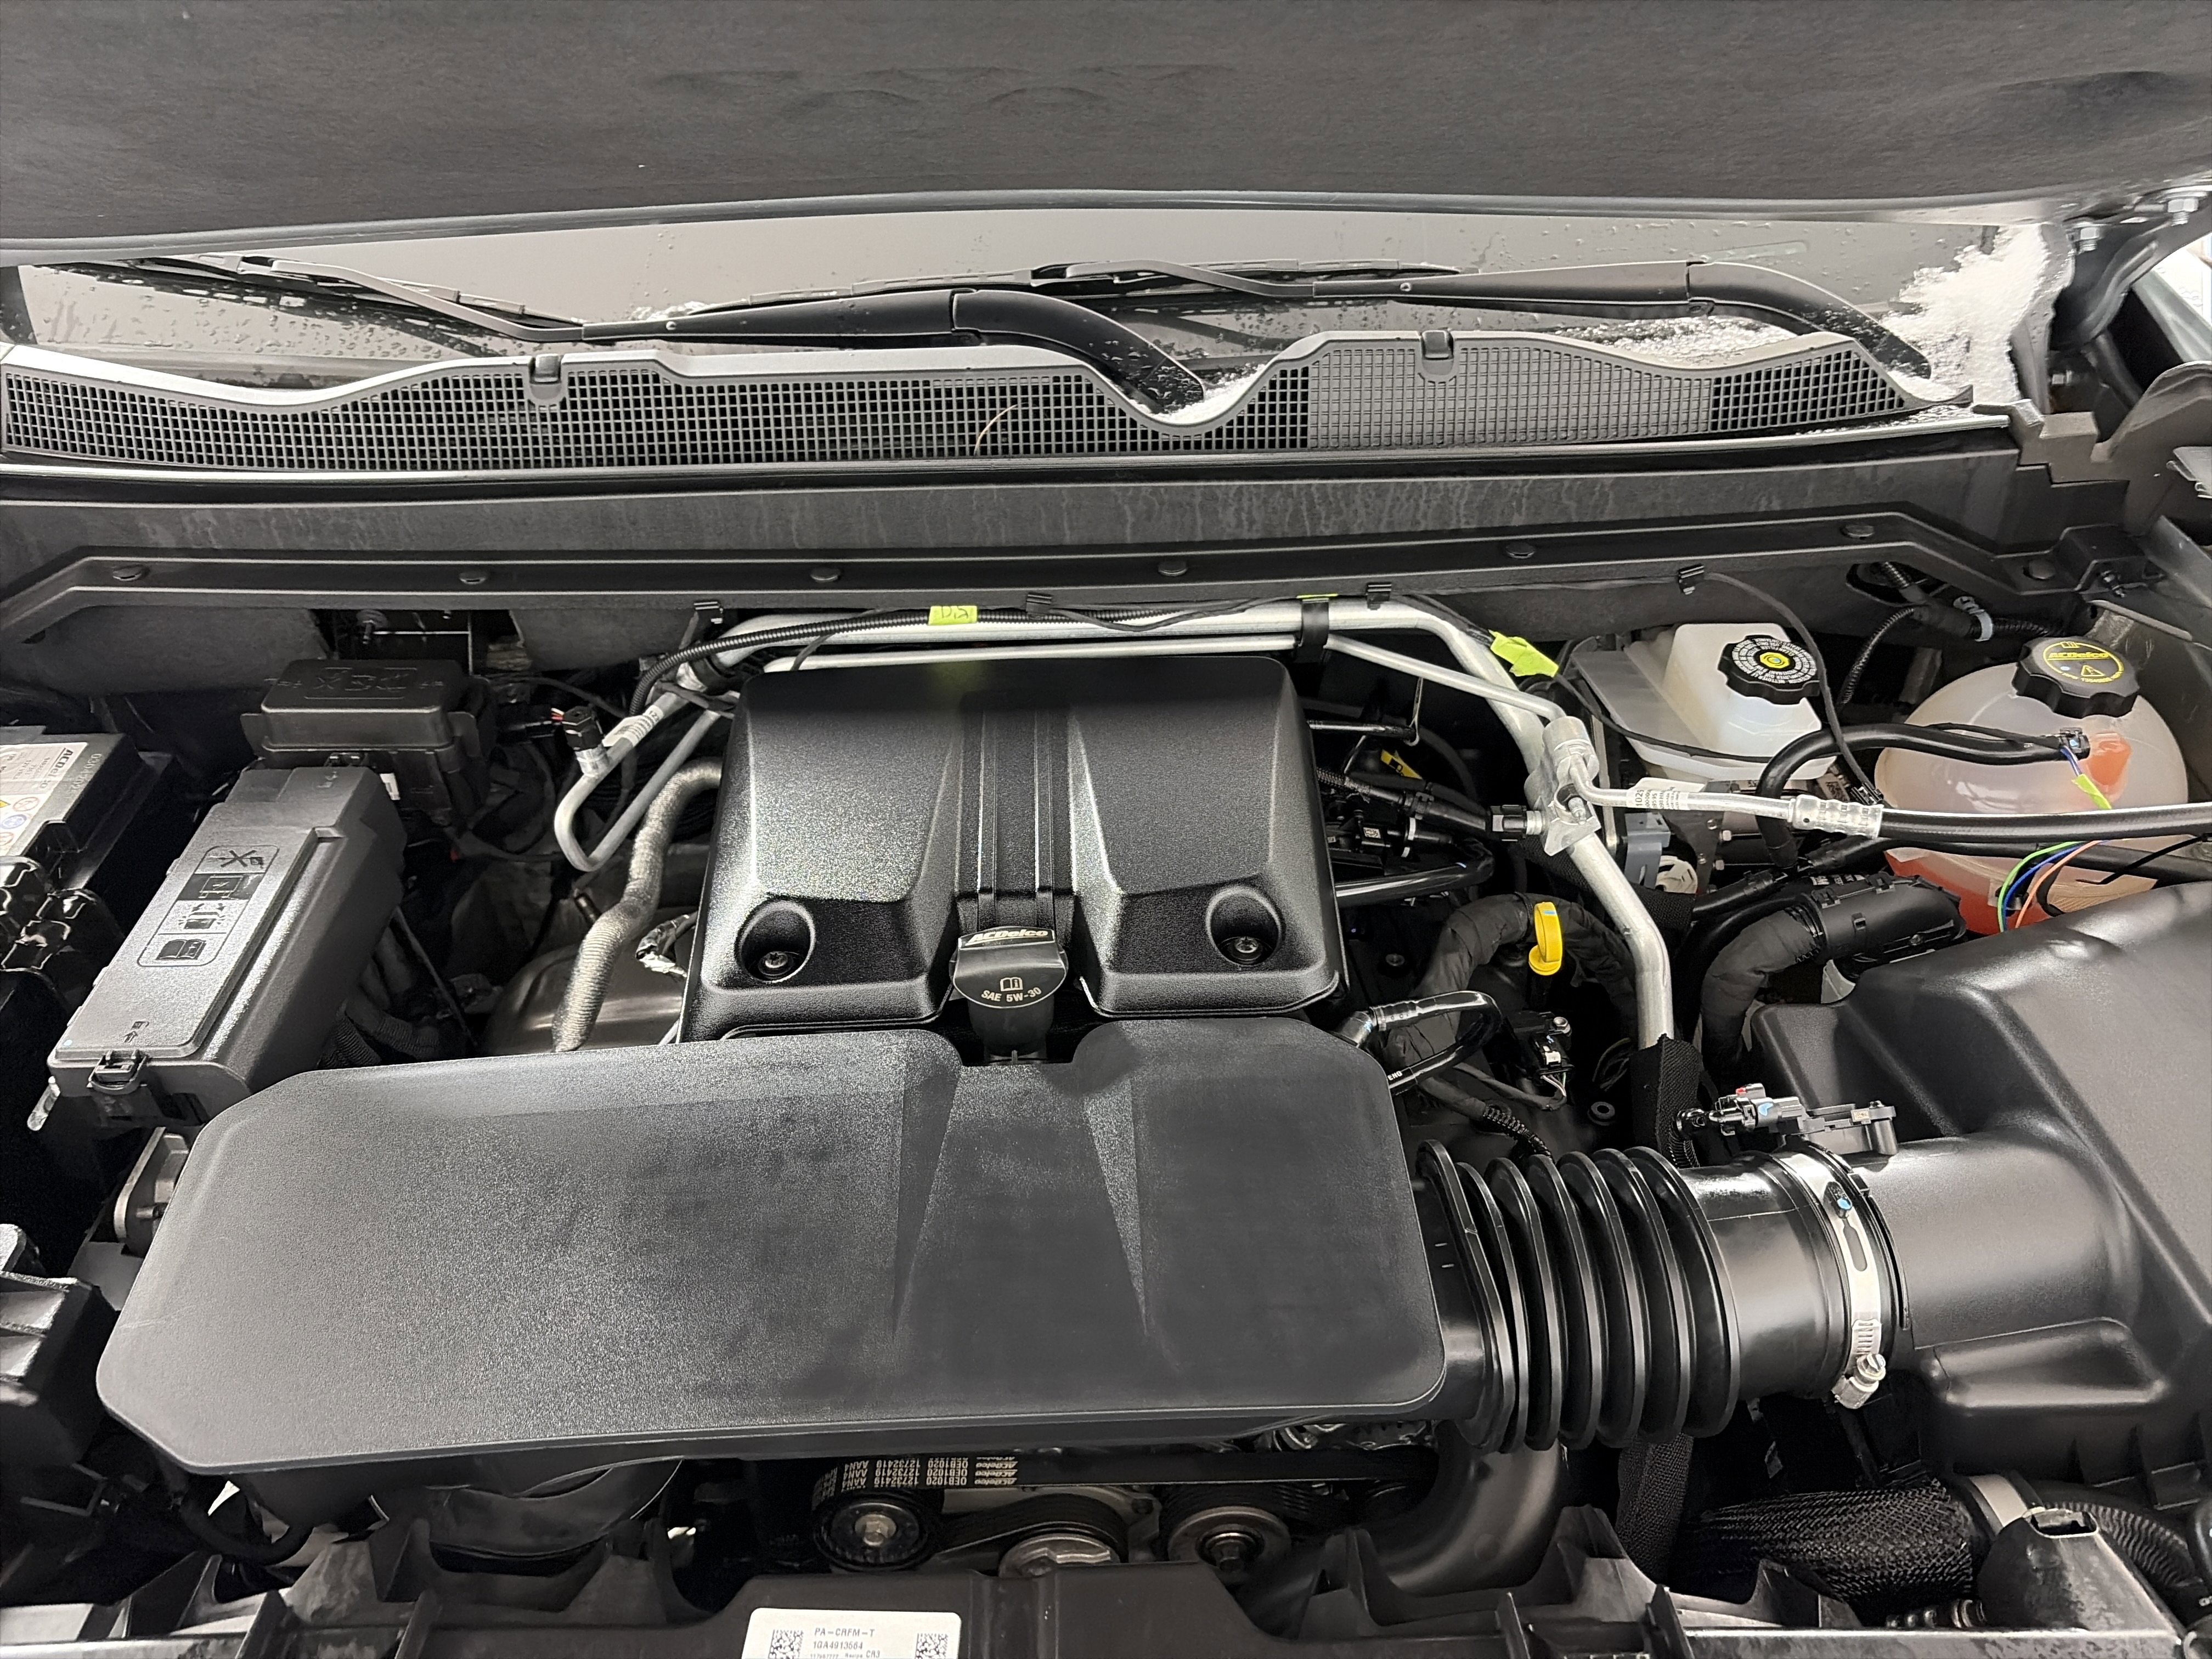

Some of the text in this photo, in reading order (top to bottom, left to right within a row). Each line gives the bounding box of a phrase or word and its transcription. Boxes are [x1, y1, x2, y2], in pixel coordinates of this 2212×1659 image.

[967, 929, 1048, 945] ACDelco
[981, 987, 1042, 1002] SAE 5W-30
[814, 1627, 875, 1638] PA-CRFM-T
